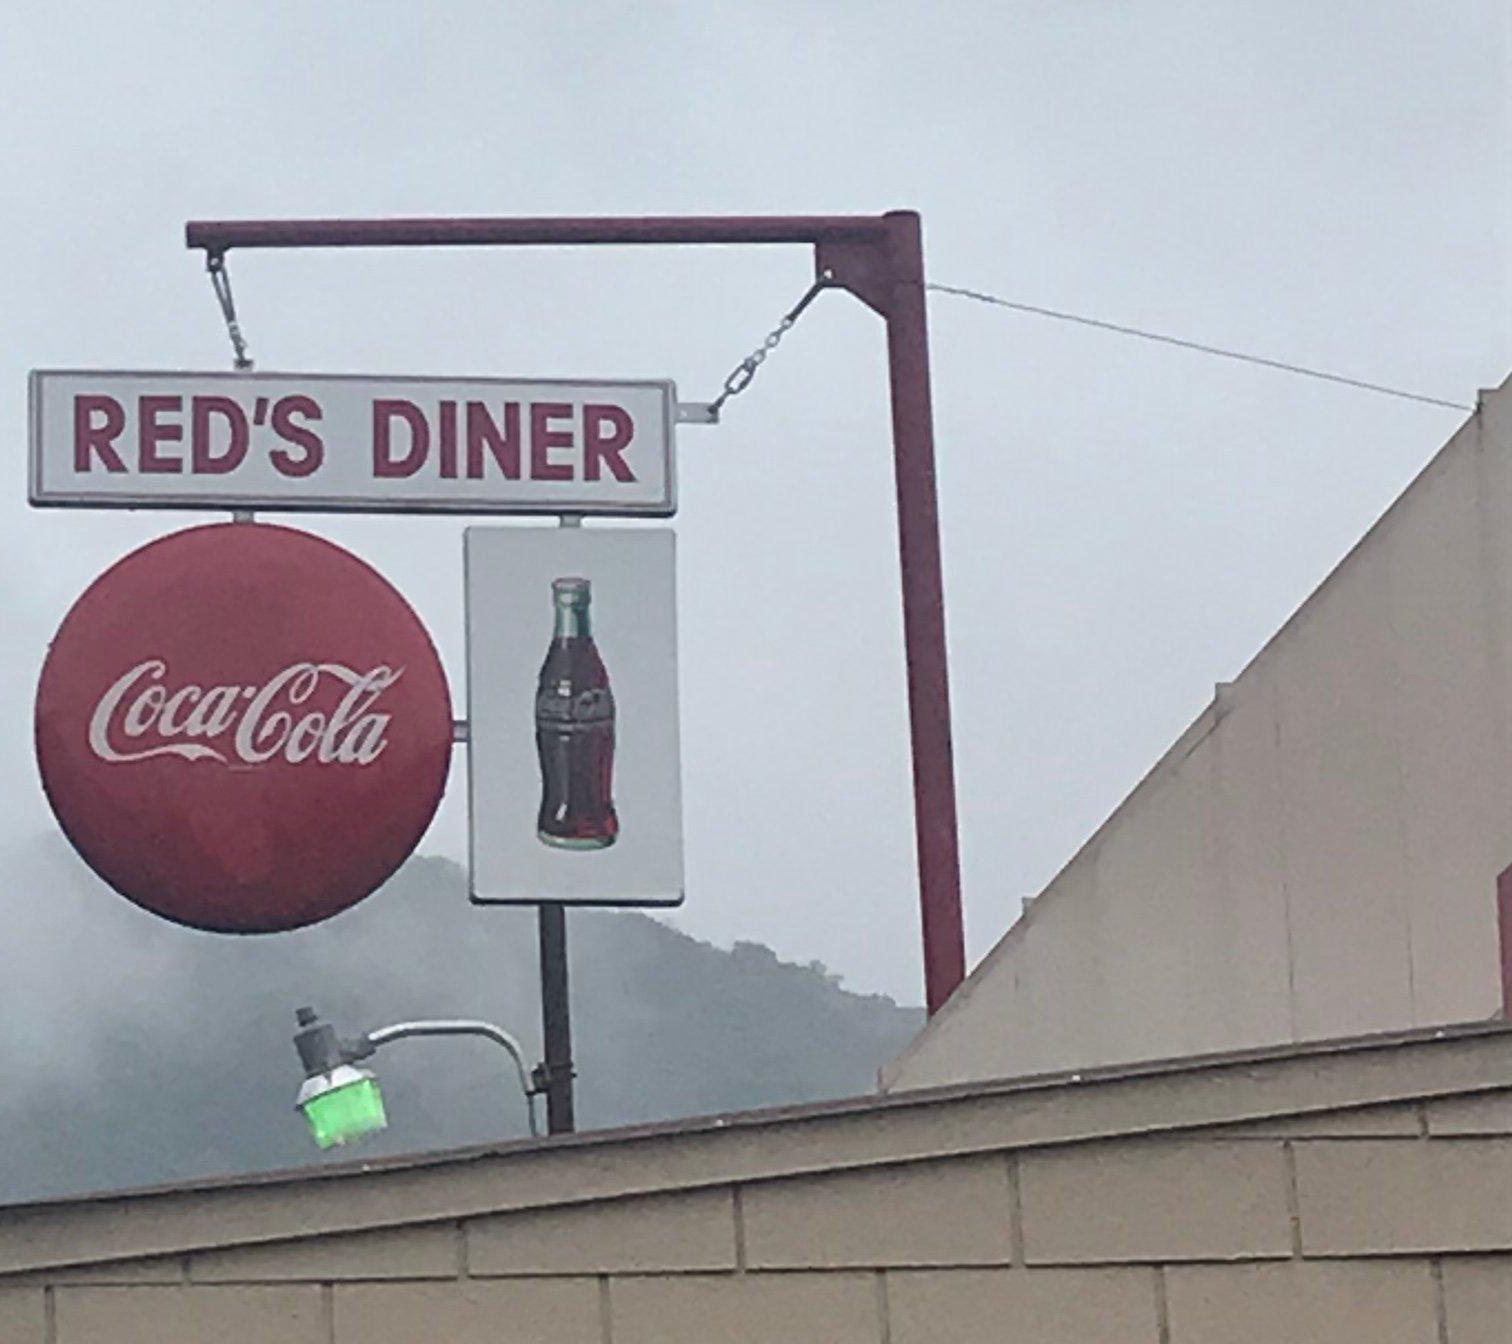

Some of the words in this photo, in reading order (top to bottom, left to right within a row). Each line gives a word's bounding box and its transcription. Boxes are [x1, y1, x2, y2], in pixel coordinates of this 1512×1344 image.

[73, 394, 325, 478] RED'S
[372, 398, 638, 483] DINER
[88, 659, 405, 767] Coca-Cola
